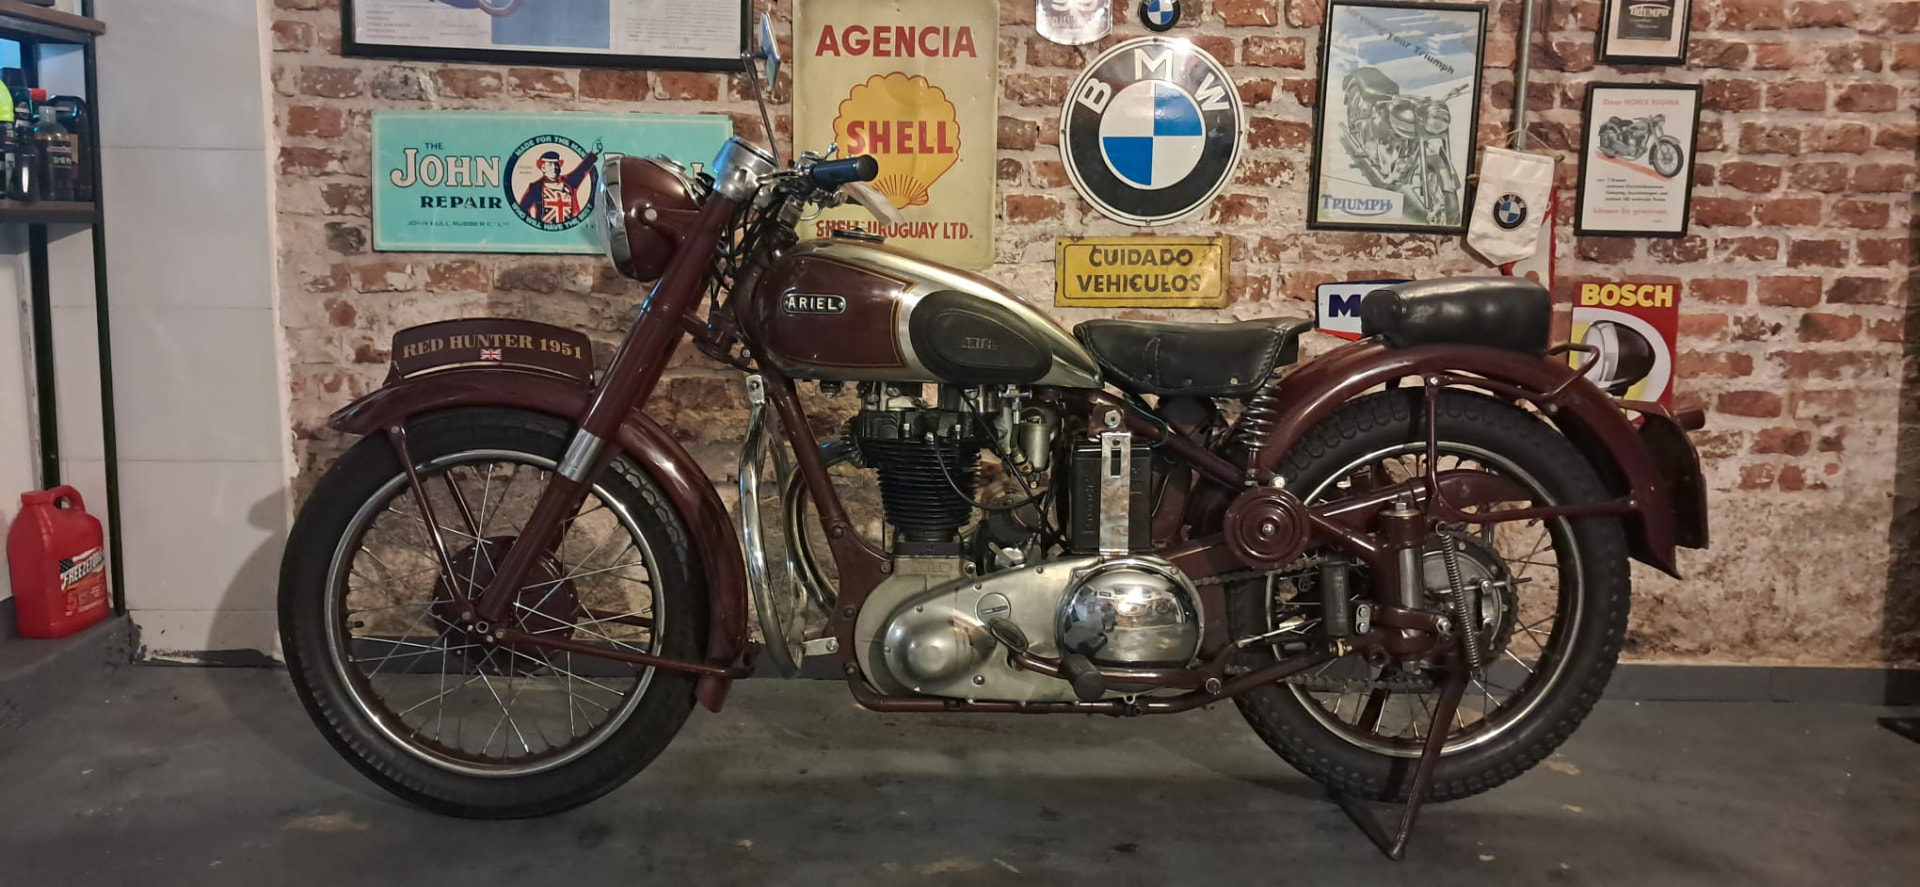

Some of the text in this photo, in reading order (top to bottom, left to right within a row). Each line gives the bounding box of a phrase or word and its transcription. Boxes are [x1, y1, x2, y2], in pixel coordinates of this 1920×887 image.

[815, 25, 977, 58] AGENCIA
[1414, 46, 1455, 75] Triumph
[1077, 48, 1230, 114] BMW
[425, 142, 444, 150] THE
[514, 140, 534, 156] MADE
[536, 136, 552, 144] FOR
[554, 136, 570, 147] THE
[846, 120, 954, 154] SHELL
[390, 147, 500, 188] JOHN
[421, 196, 502, 208] REPAIR
[1321, 194, 1393, 210] TRIUMPH
[511, 203, 526, 218] WHO
[526, 217, 542, 229] WILL
[868, 220, 938, 239] URUGUAY
[943, 222, 974, 239] LTD.
[1089, 248, 1194, 267] CUIDADO
[1077, 274, 1201, 292] VEHICULOS
[788, 296, 838, 310] ARIEL
[1581, 284, 1674, 307] BOSCH
[404, 334, 582, 359] RED HUNTER 1951
